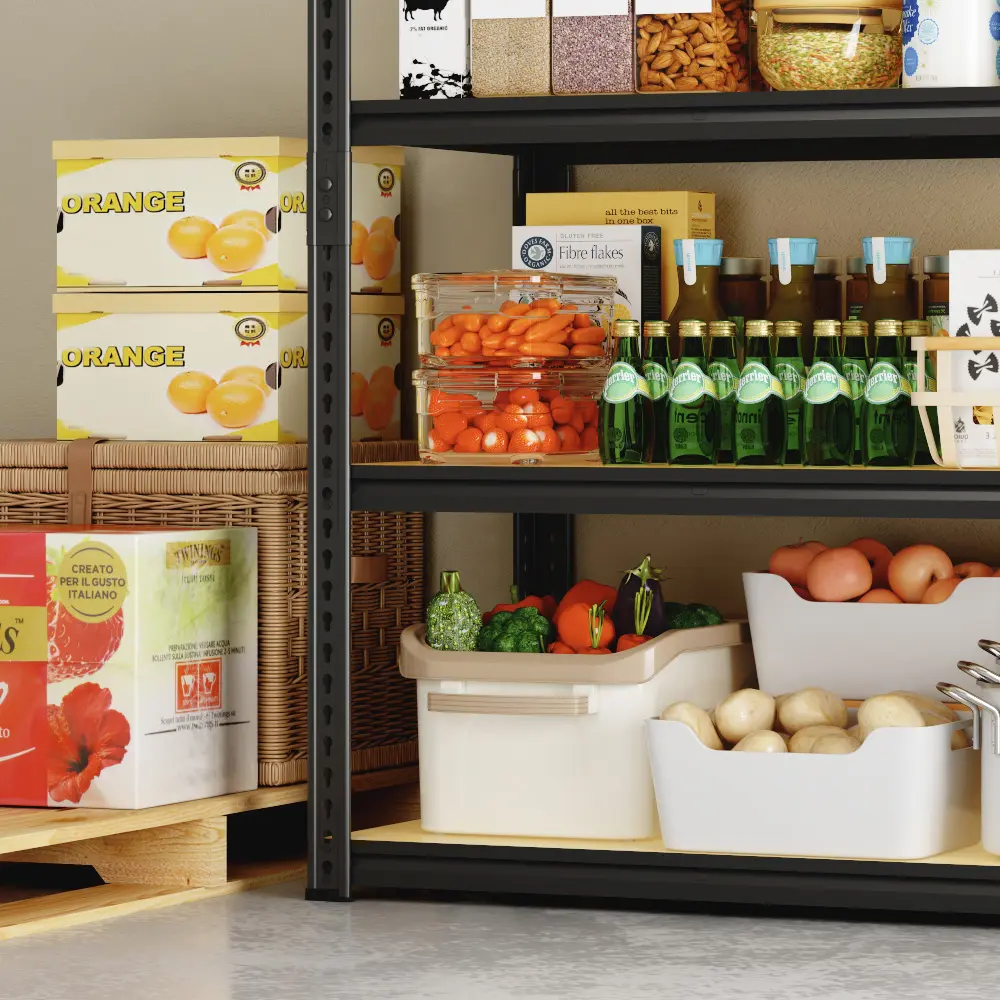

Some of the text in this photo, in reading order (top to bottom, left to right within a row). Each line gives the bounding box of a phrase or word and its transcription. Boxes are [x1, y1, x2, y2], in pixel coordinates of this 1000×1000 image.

[61, 190, 185, 214] ORANGE
[619, 208, 636, 216] the
[521, 239, 552, 254] DOVES FARM
[559, 244, 624, 260] Fibre flakes
[523, 256, 551, 268] ORGANIC
[61, 345, 185, 368] ORANGE
[174, 543, 222, 566] TWININGS
[71, 564, 114, 574] CREATO
[60, 577, 126, 587] PER IL GUSTO
[68, 589, 118, 600] ITALIANO
